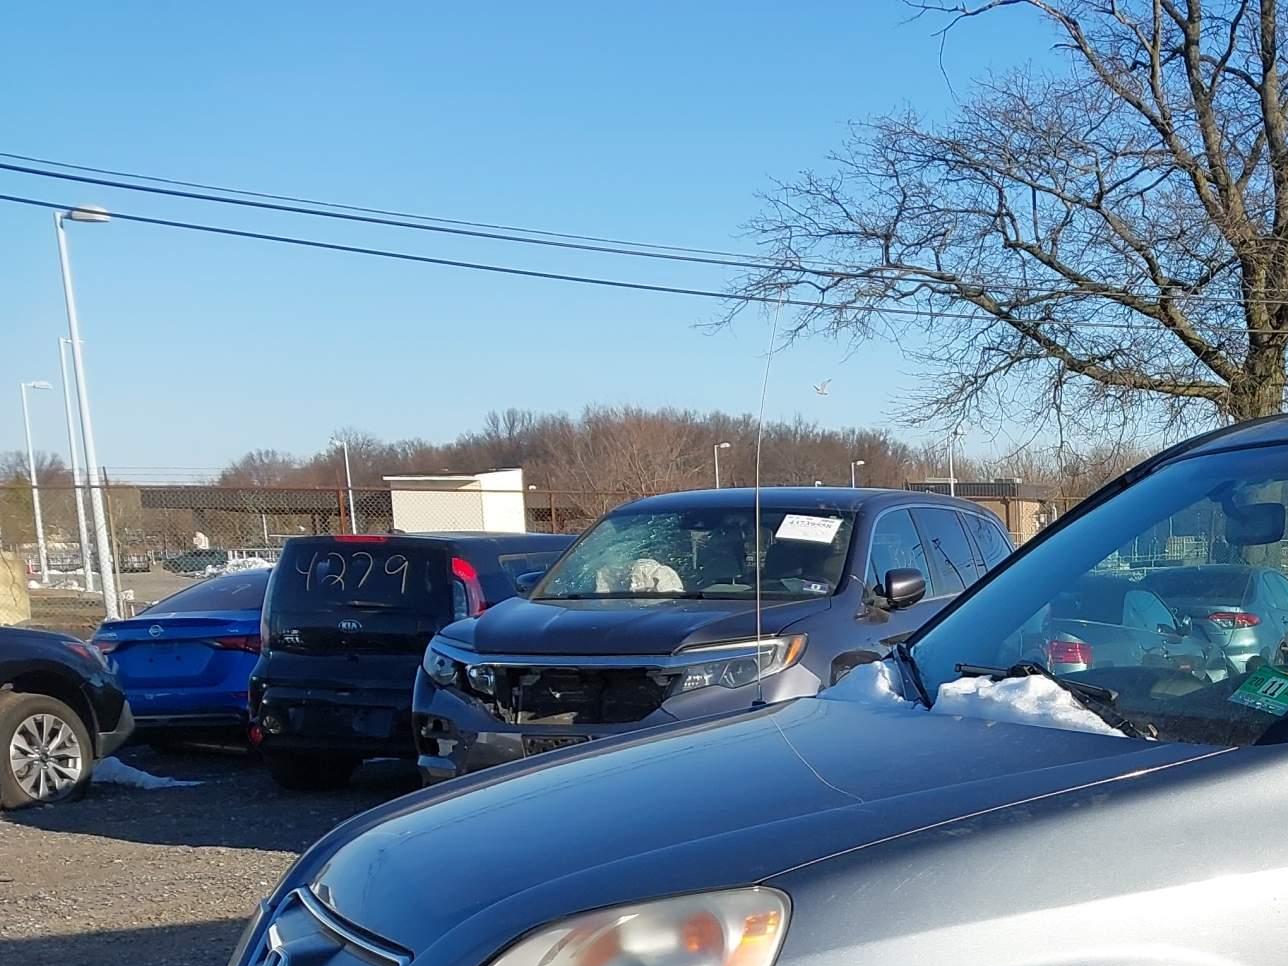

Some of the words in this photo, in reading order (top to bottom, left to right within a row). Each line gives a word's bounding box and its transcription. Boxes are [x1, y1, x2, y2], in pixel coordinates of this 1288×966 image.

[295, 551, 409, 594] 4279
[341, 622, 357, 631] KIA
[1261, 680, 1285, 697] 11
